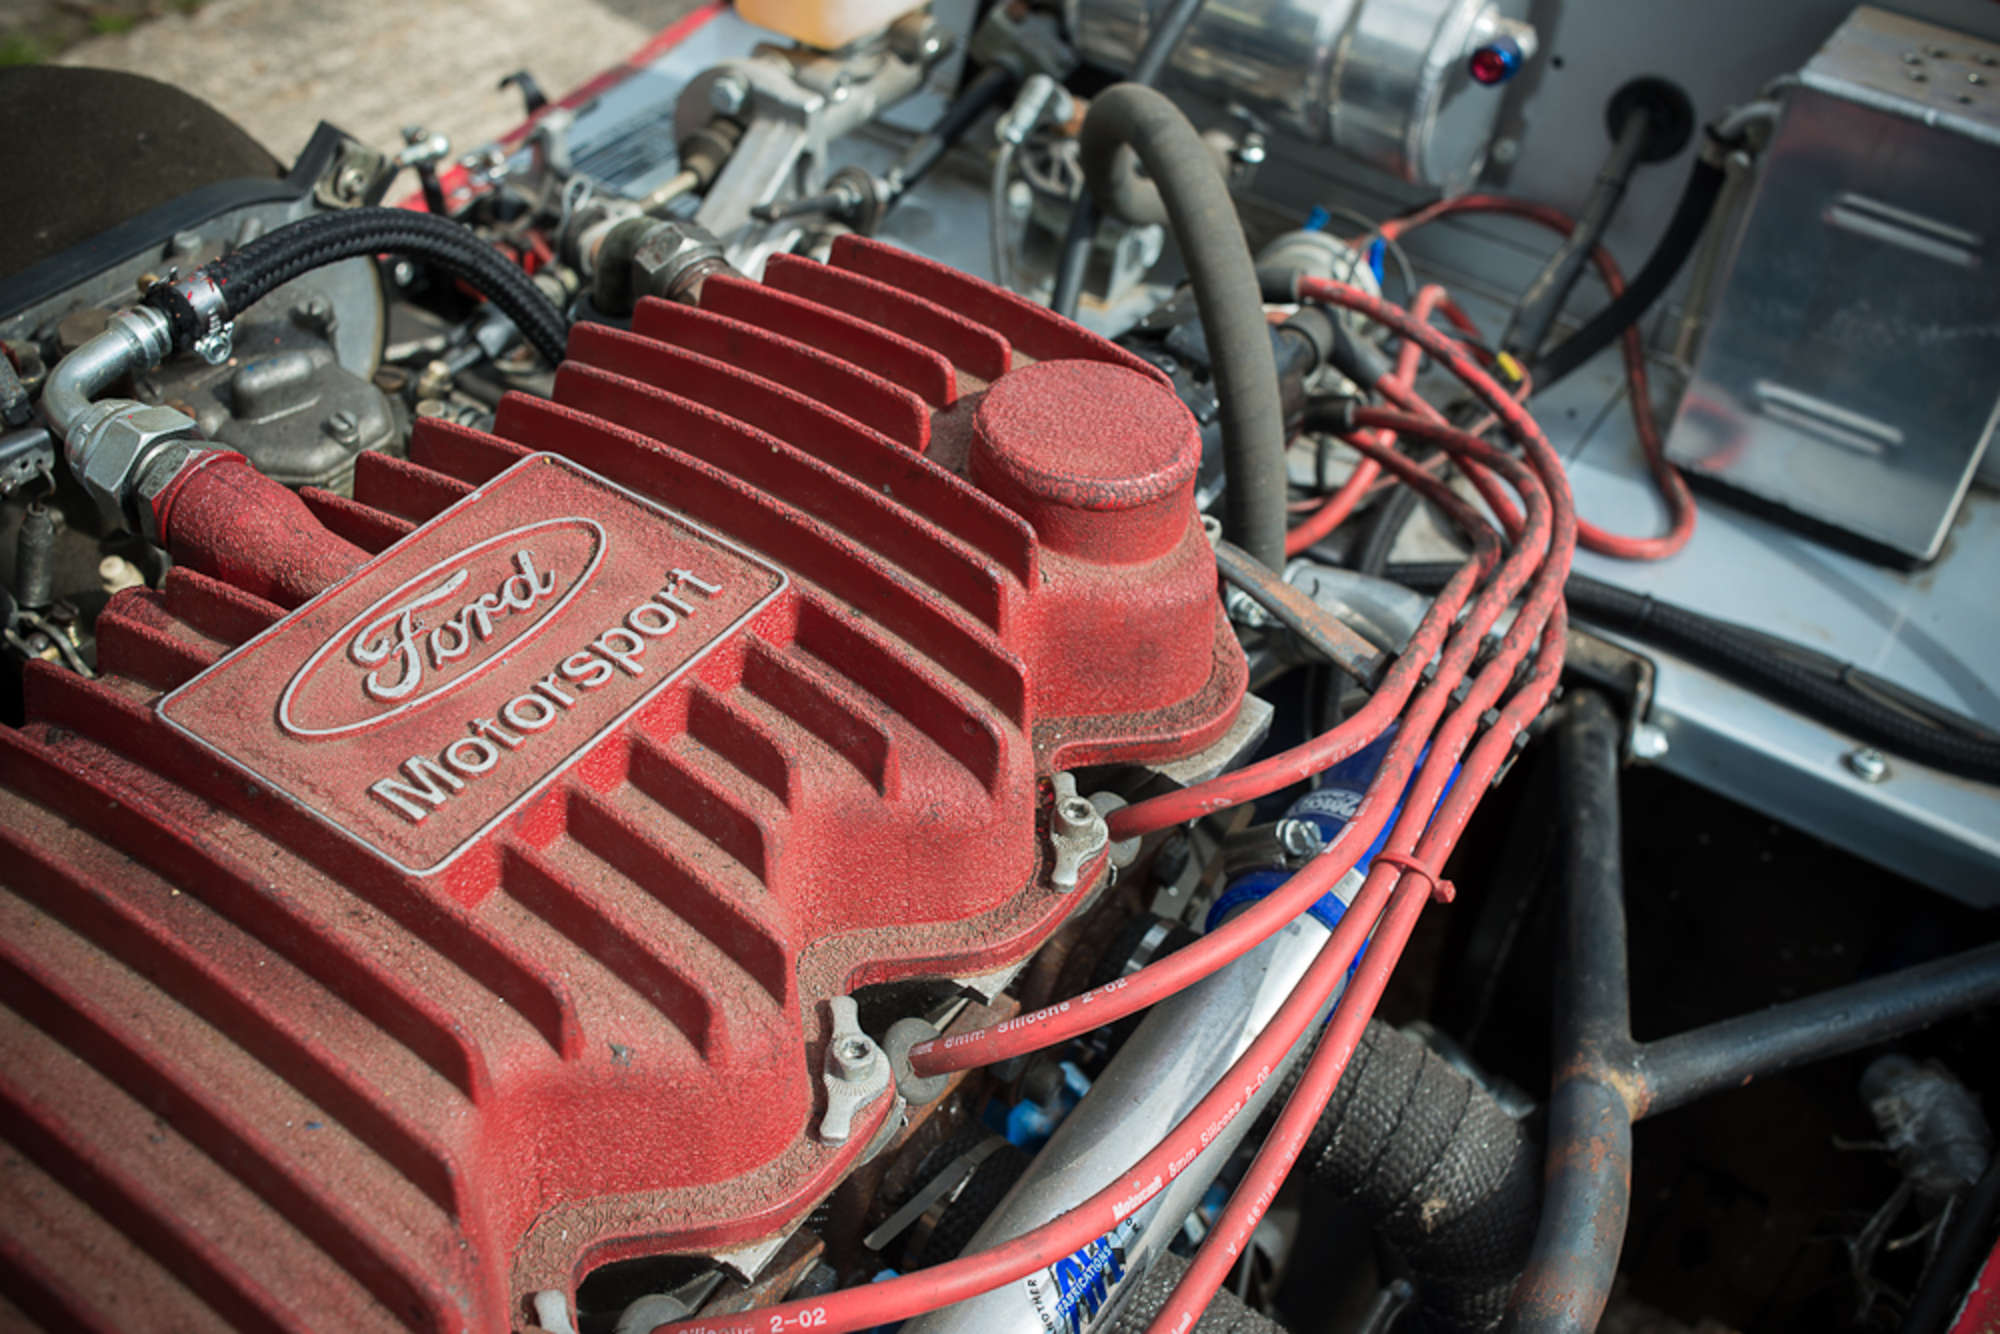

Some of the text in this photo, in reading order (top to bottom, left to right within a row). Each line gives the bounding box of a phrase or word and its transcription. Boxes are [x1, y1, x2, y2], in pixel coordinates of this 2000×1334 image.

[349, 550, 556, 700] Ford
[370, 567, 724, 823] Motorsport
[1081, 977, 1129, 1004] 2-02
[1168, 1148, 1197, 1178] 8mm
[1200, 1102, 1241, 1146] Silicone
[1027, 1278, 1057, 1334] NOTHER
[1055, 1244, 1113, 1316] FABRICATIONS
[769, 1307, 827, 1333] 2-02
